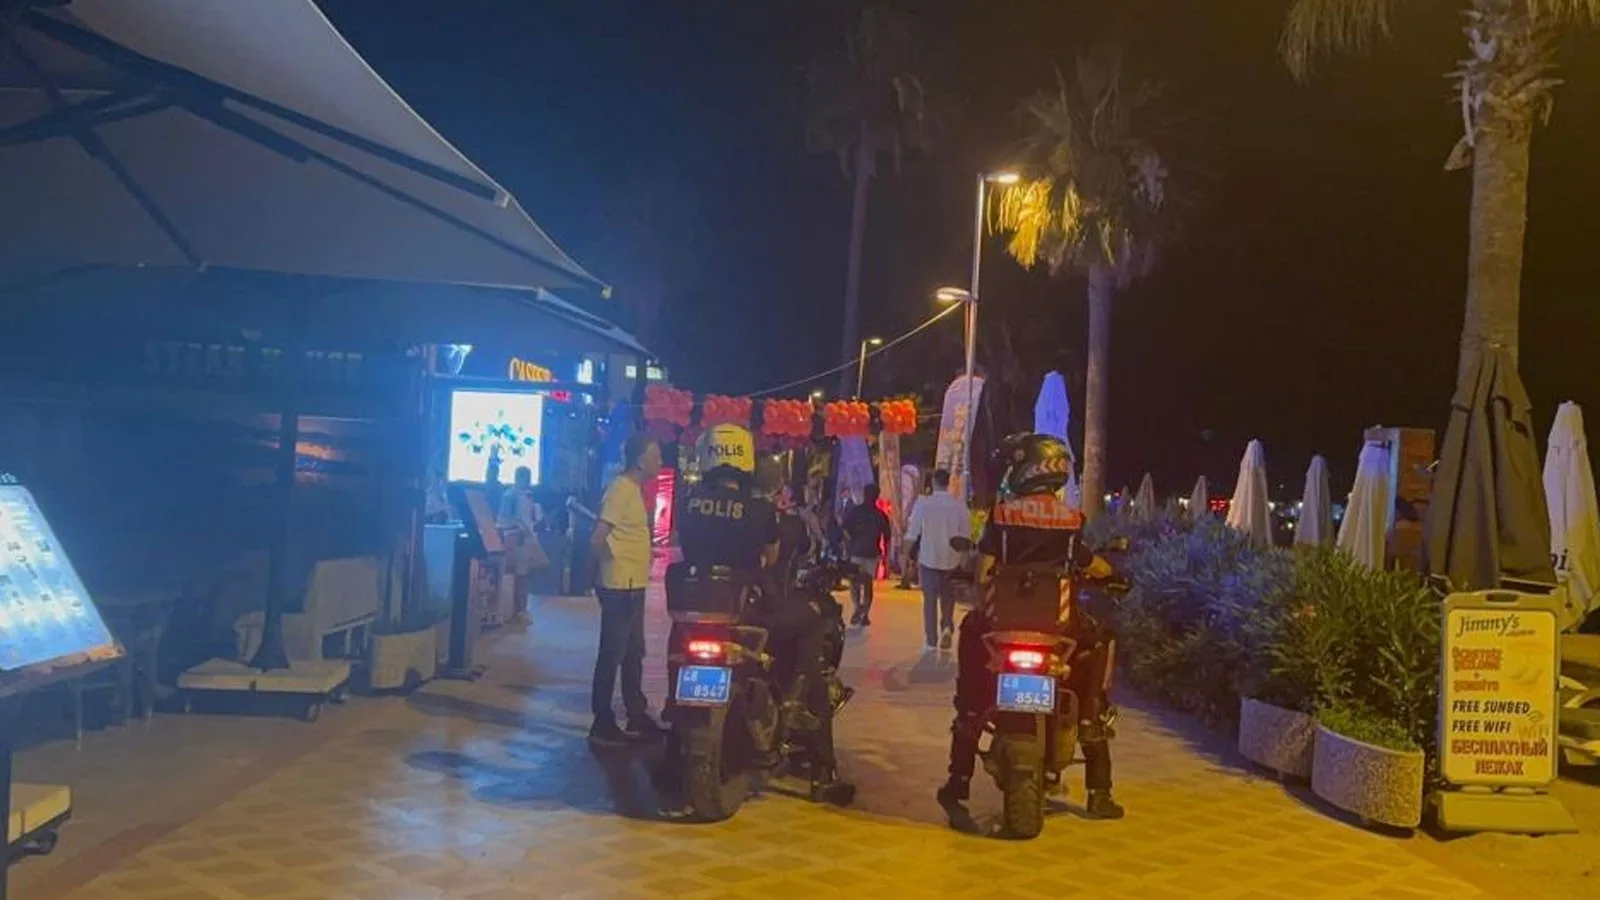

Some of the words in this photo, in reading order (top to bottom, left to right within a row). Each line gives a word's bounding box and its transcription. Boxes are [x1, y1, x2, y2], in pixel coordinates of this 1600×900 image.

[1452, 700, 1481, 714] FREE
[1483, 700, 1530, 714] SUNBED
[1452, 719, 1482, 733] FREE
[1483, 719, 1511, 733] WIFI
